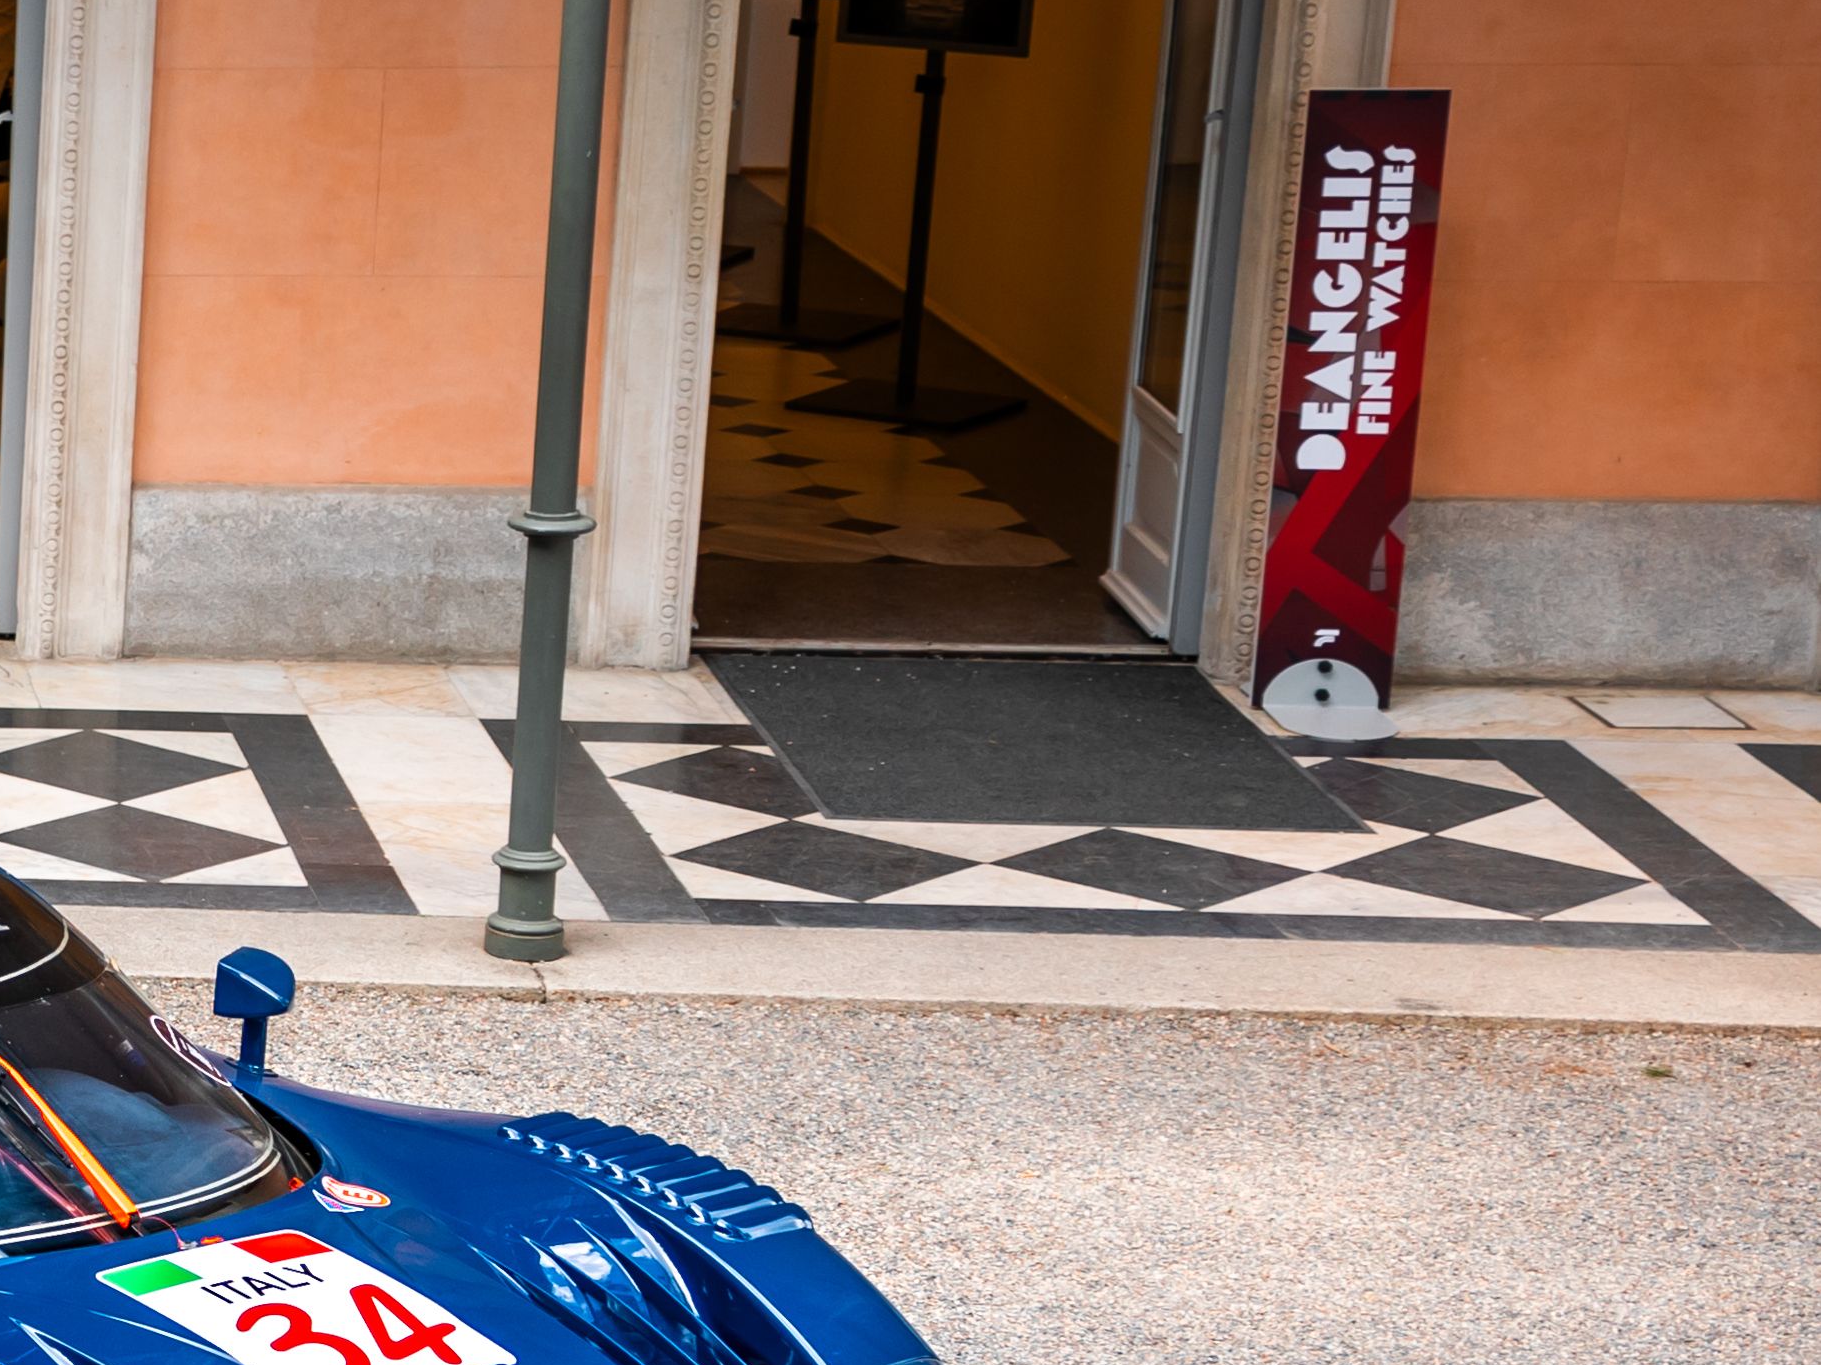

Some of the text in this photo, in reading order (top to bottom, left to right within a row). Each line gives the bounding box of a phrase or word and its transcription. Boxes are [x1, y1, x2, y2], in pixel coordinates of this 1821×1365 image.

[1296, 145, 1375, 470] DEANGELIS
[1356, 145, 1417, 435] FINE WATCHES
[201, 1263, 324, 1304] ITALY
